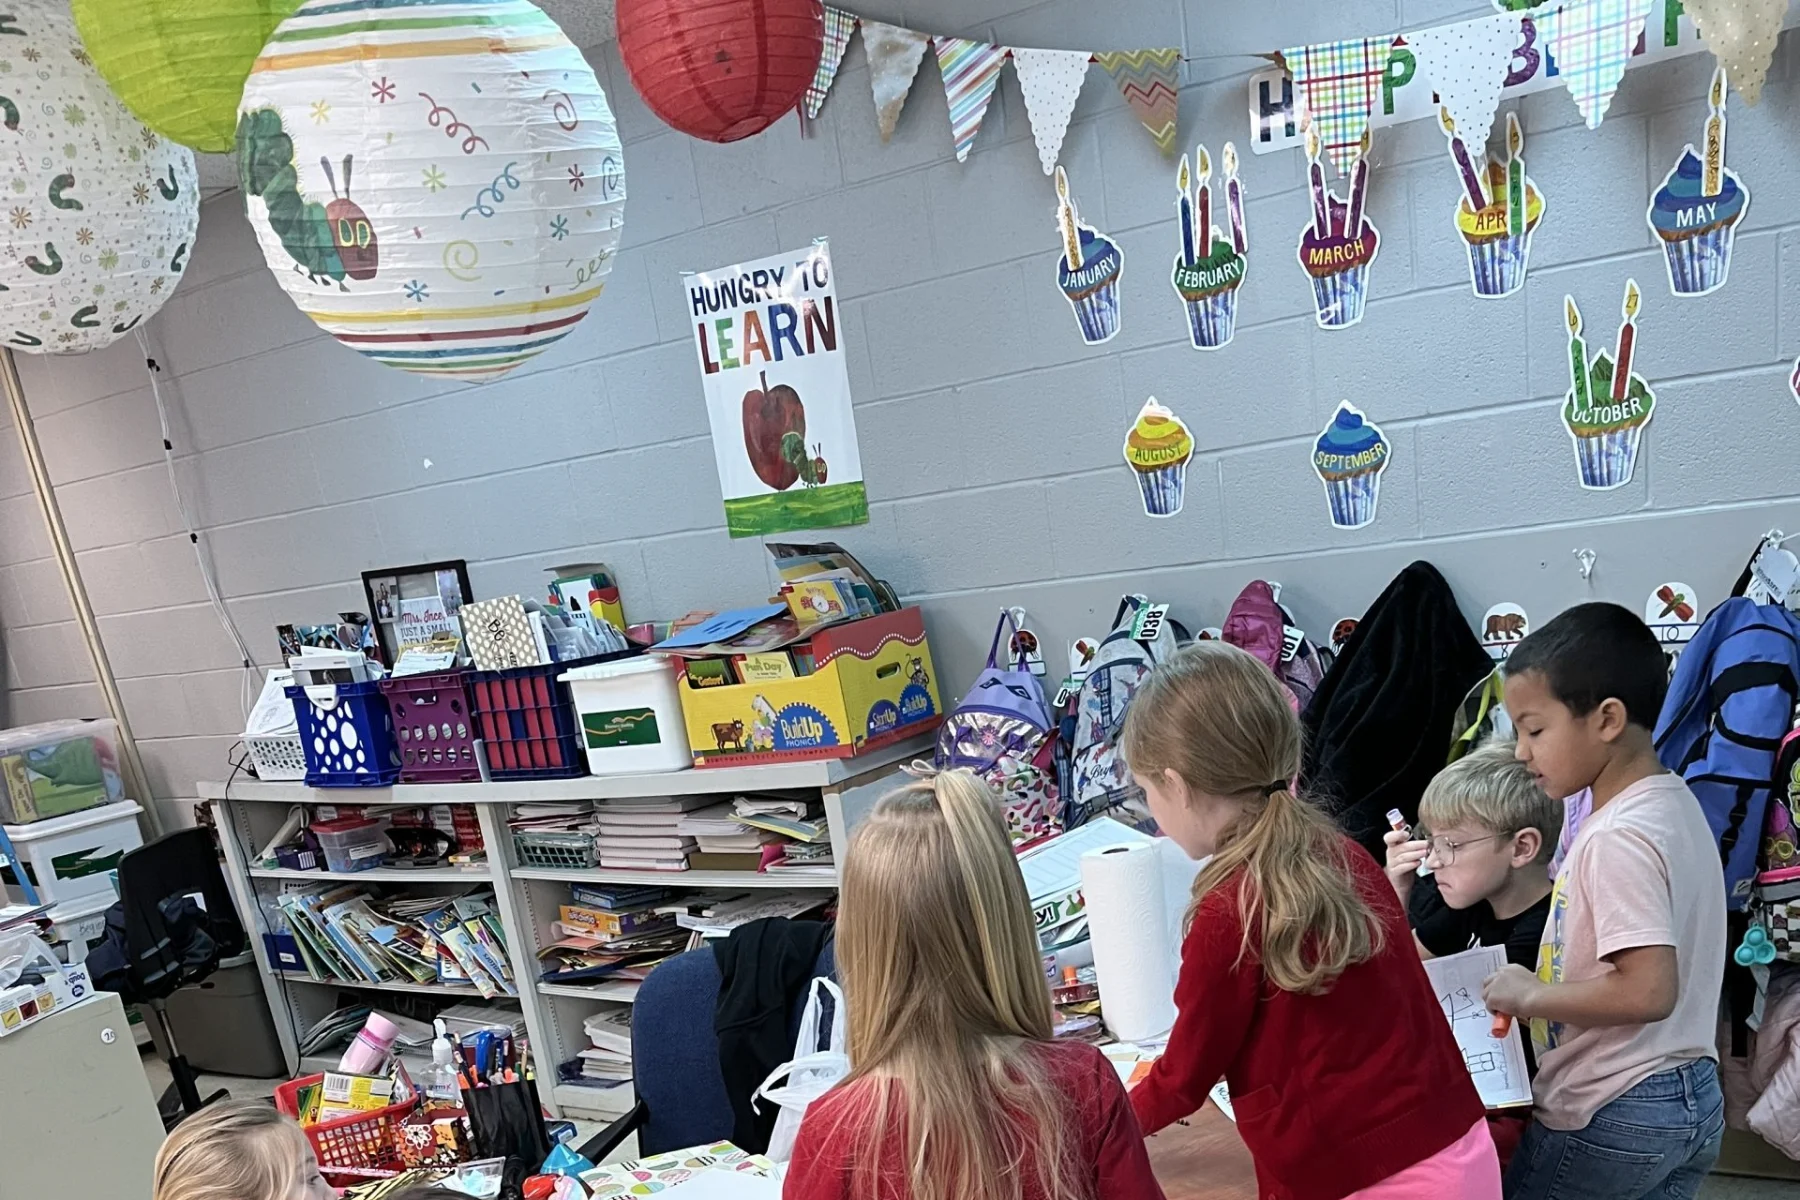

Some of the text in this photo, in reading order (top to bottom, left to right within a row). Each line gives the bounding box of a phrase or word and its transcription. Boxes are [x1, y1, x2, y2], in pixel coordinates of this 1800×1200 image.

[1475, 211, 1508, 231] APR
[1676, 201, 1716, 228] MAY
[1308, 238, 1366, 267] MARCH
[1062, 253, 1117, 288] JANUARY
[1176, 260, 1242, 289] FEBRUARY
[690, 257, 829, 317] HUNGRY TO
[1625, 294, 1639, 309] 27
[697, 295, 837, 375] LEARN
[1572, 397, 1644, 425] OCTOBER
[1134, 441, 1183, 463] AUGUST
[1315, 442, 1387, 471] SEPTEMBER
[1140, 610, 1164, 639] 038
[780, 716, 824, 743] BuildUp
[786, 737, 817, 748] PHONICS
